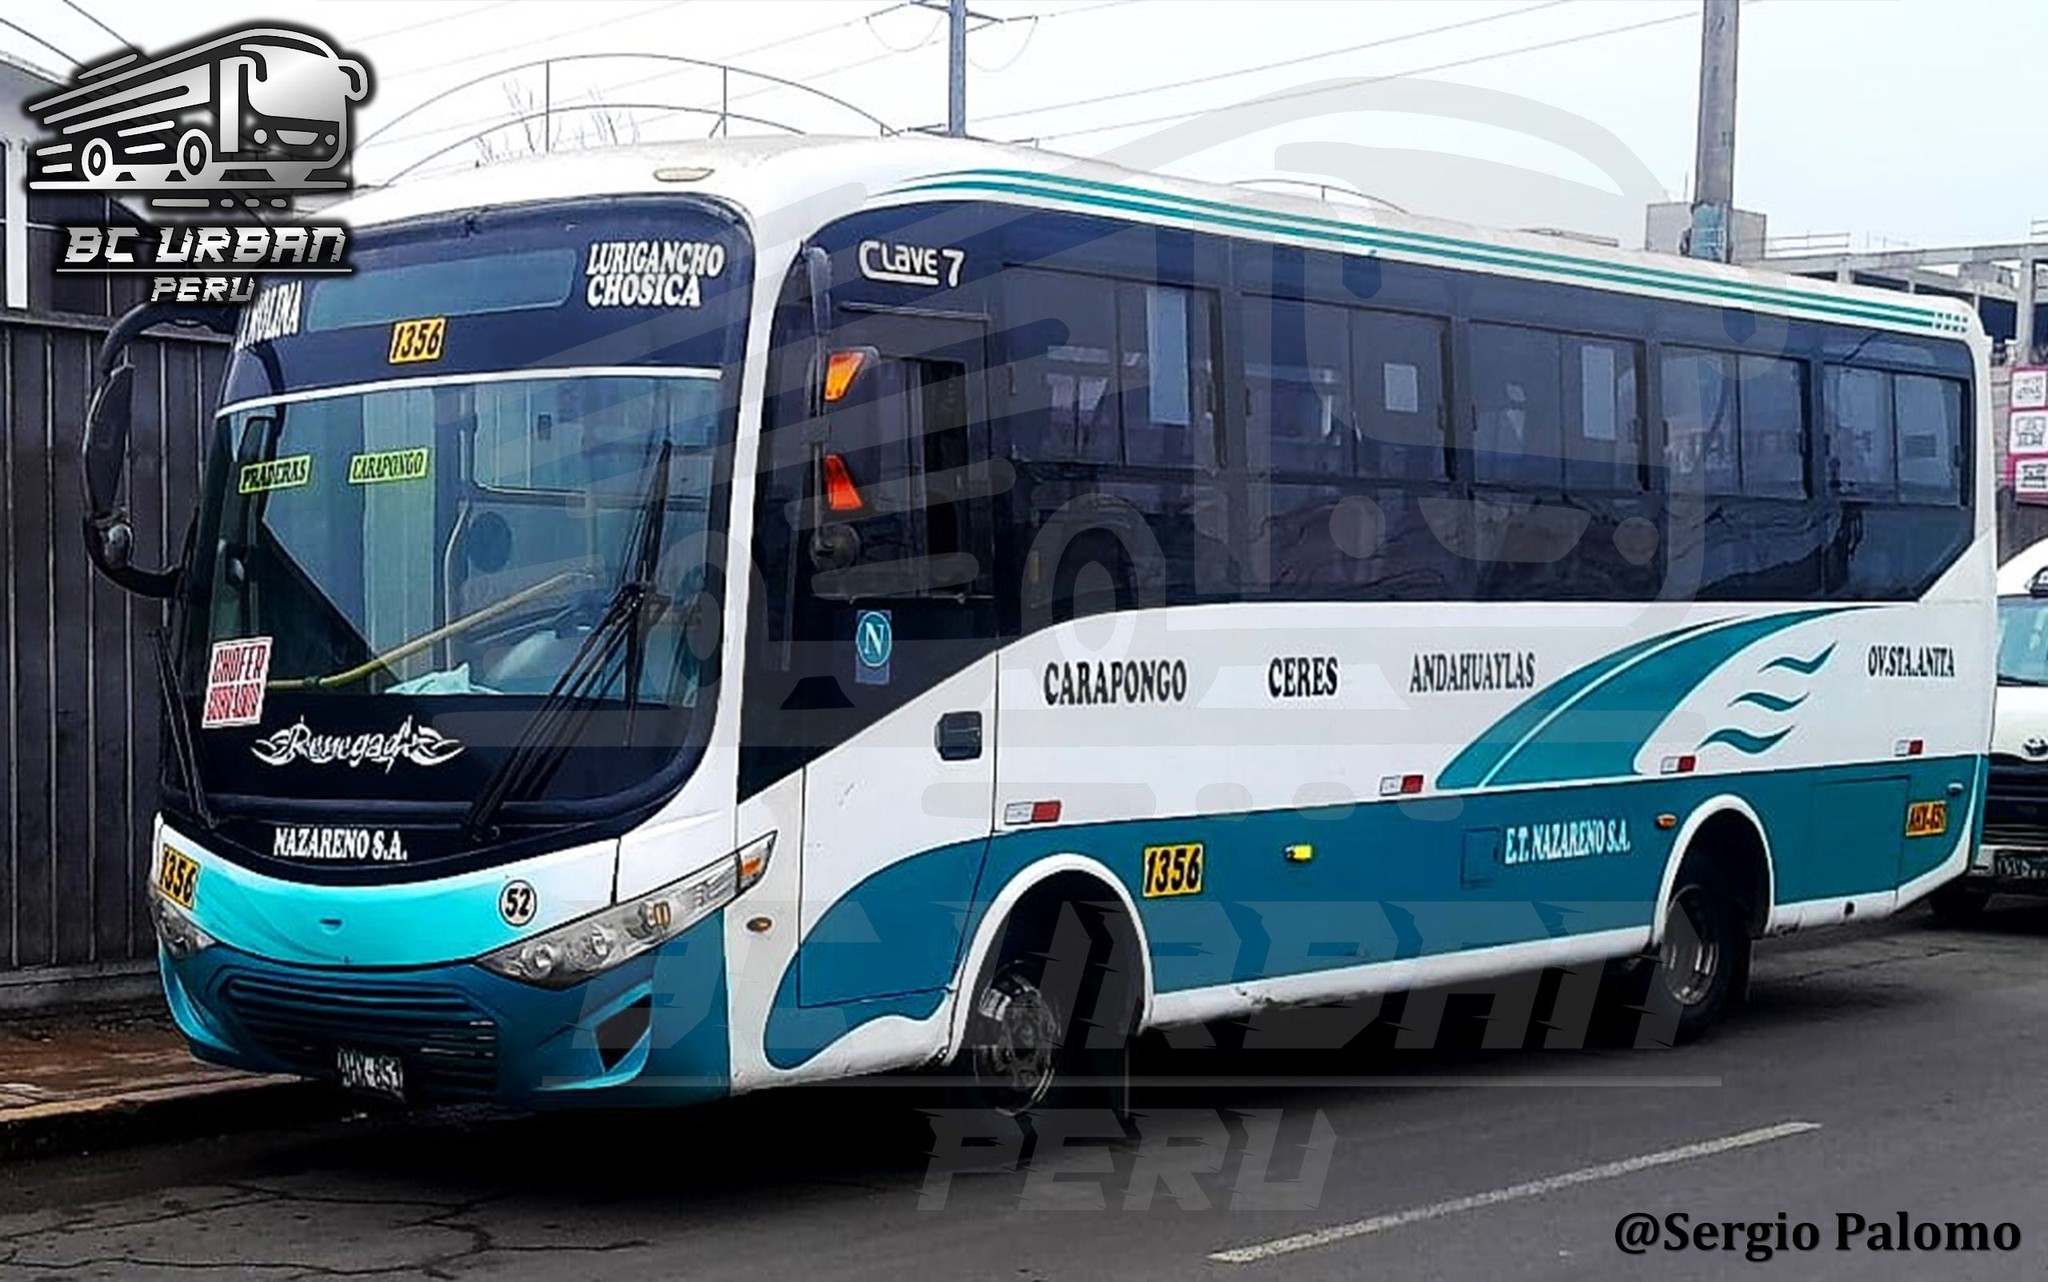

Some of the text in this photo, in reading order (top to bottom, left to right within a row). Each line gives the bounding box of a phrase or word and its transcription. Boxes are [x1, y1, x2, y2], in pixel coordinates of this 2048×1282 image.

[586, 241, 725, 277] LURIGANCHO
[941, 249, 965, 287] 7
[587, 273, 701, 309] CHOSICA
[392, 322, 442, 360] 1356
[352, 452, 424, 480] CARAPONGO
[863, 623, 885, 655] N
[1044, 659, 1187, 705] CARAPONGO
[1268, 656, 1338, 697] CERES
[1409, 652, 1536, 693] ANDAHUAYLAS
[273, 826, 408, 861] NAZARENO S.A.
[1504, 818, 1631, 865] E.T. NAZARENO S.A.
[162, 846, 196, 905] 1356
[1145, 847, 1201, 895] 1356
[504, 886, 532, 917] 52
